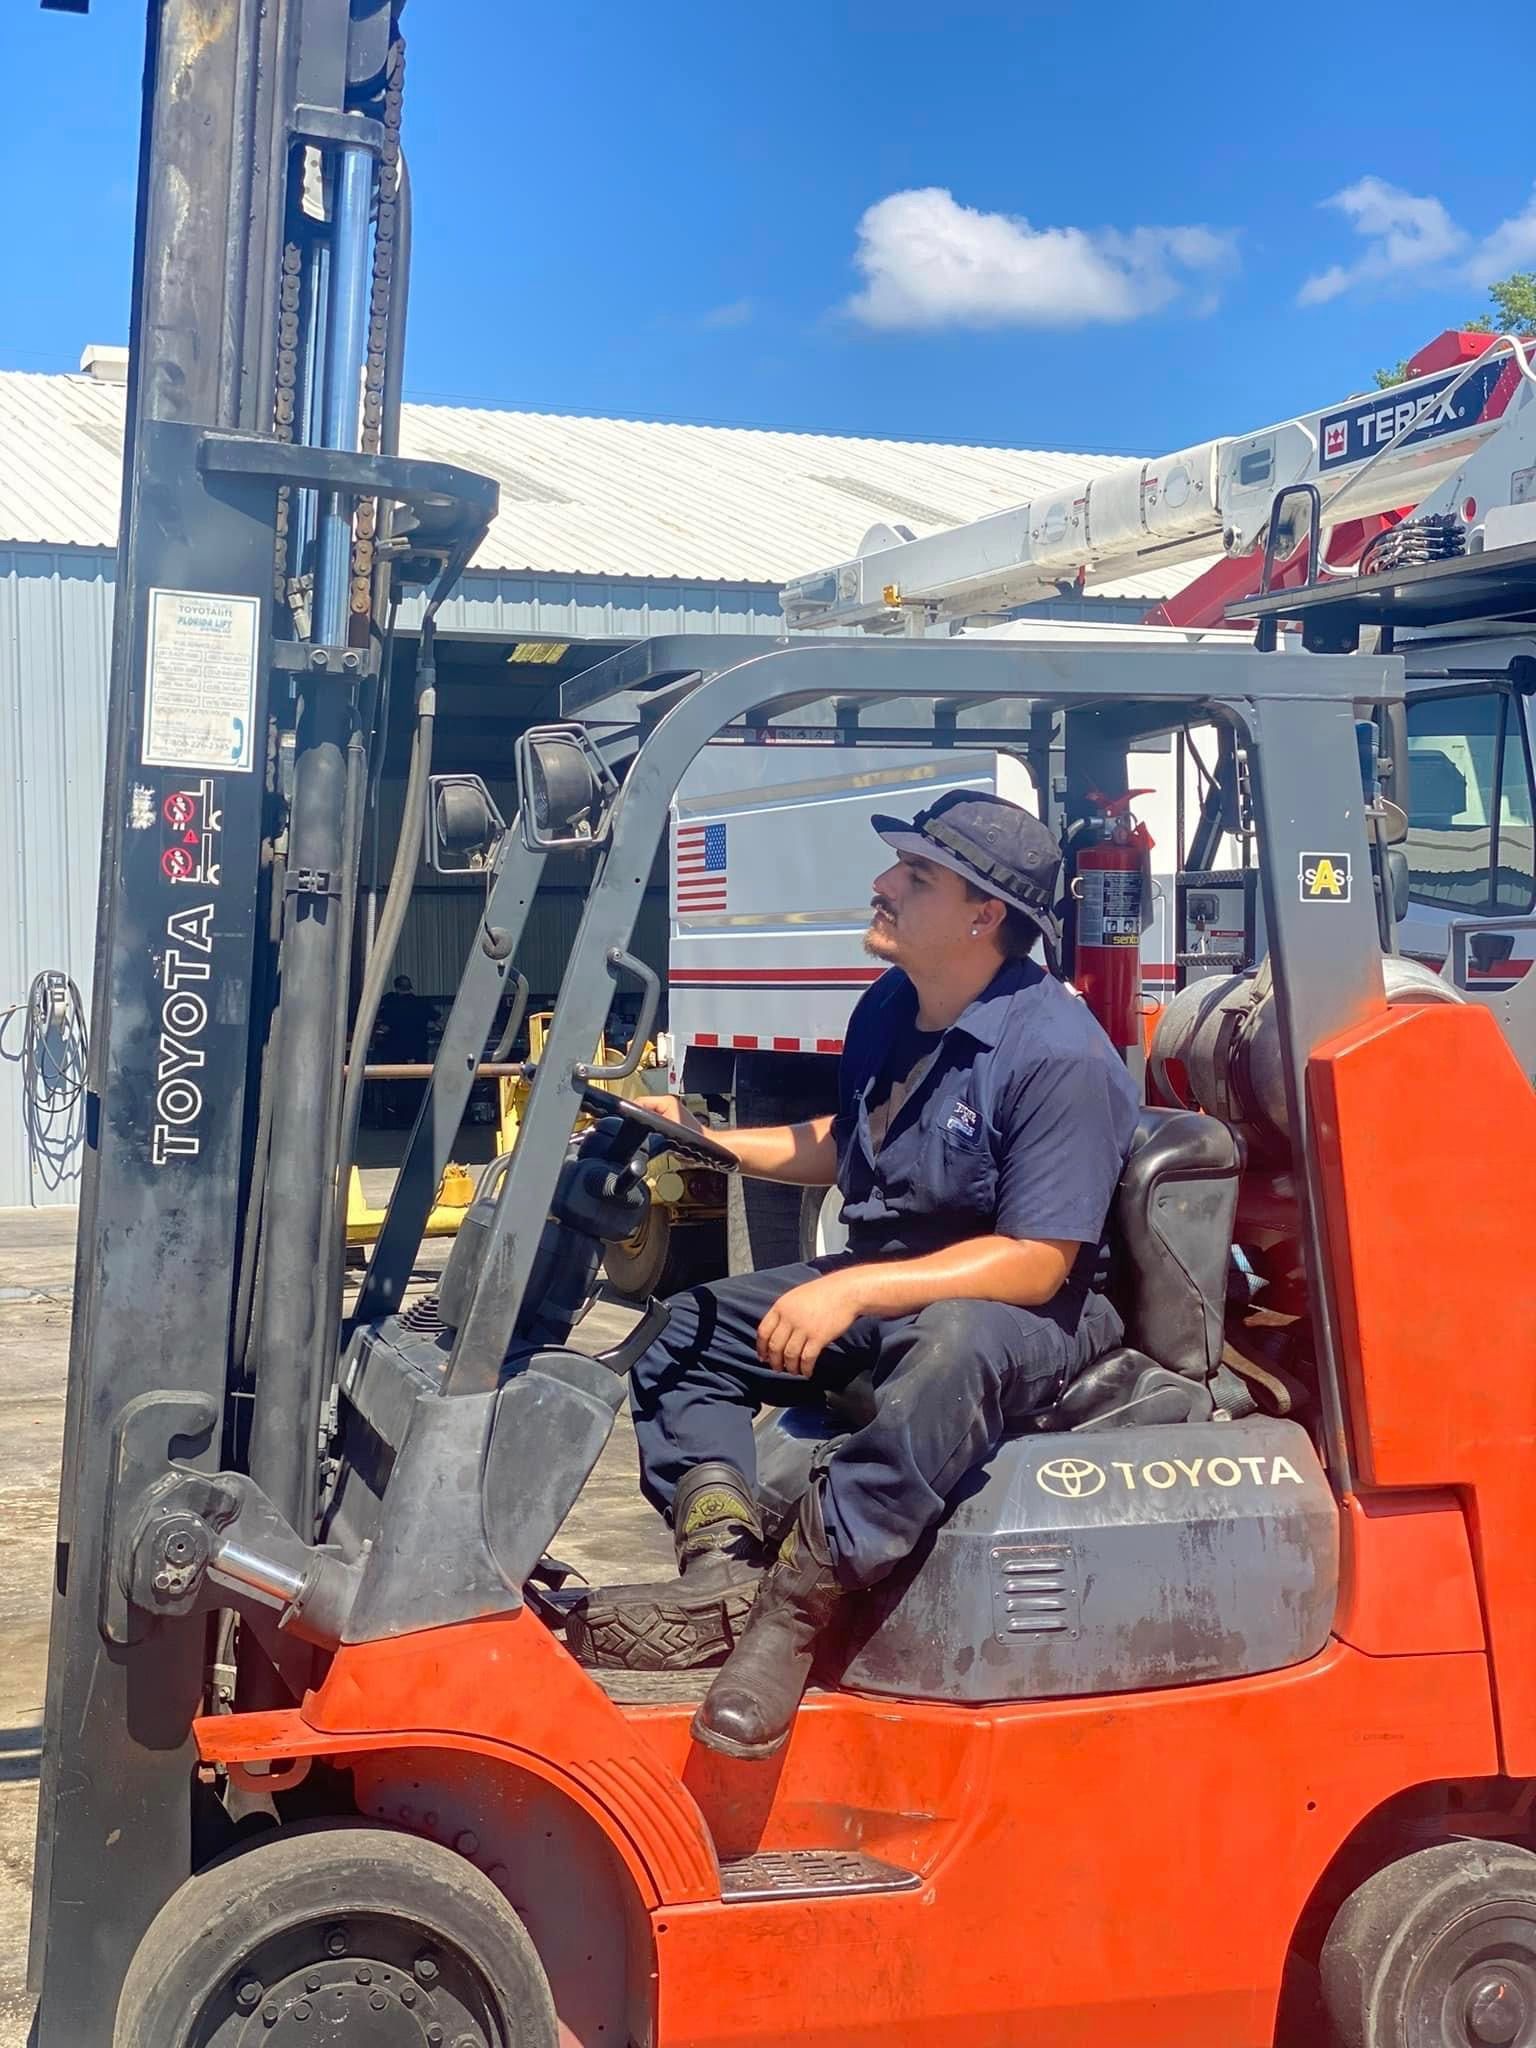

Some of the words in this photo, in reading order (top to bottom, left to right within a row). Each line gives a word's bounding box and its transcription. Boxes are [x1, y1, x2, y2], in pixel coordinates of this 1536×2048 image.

[1357, 392, 1459, 447] TEREX
[1304, 859, 1346, 895] SAS
[153, 903, 215, 1165] TOYOTA
[1111, 1456, 1304, 1490] TOYOTA
